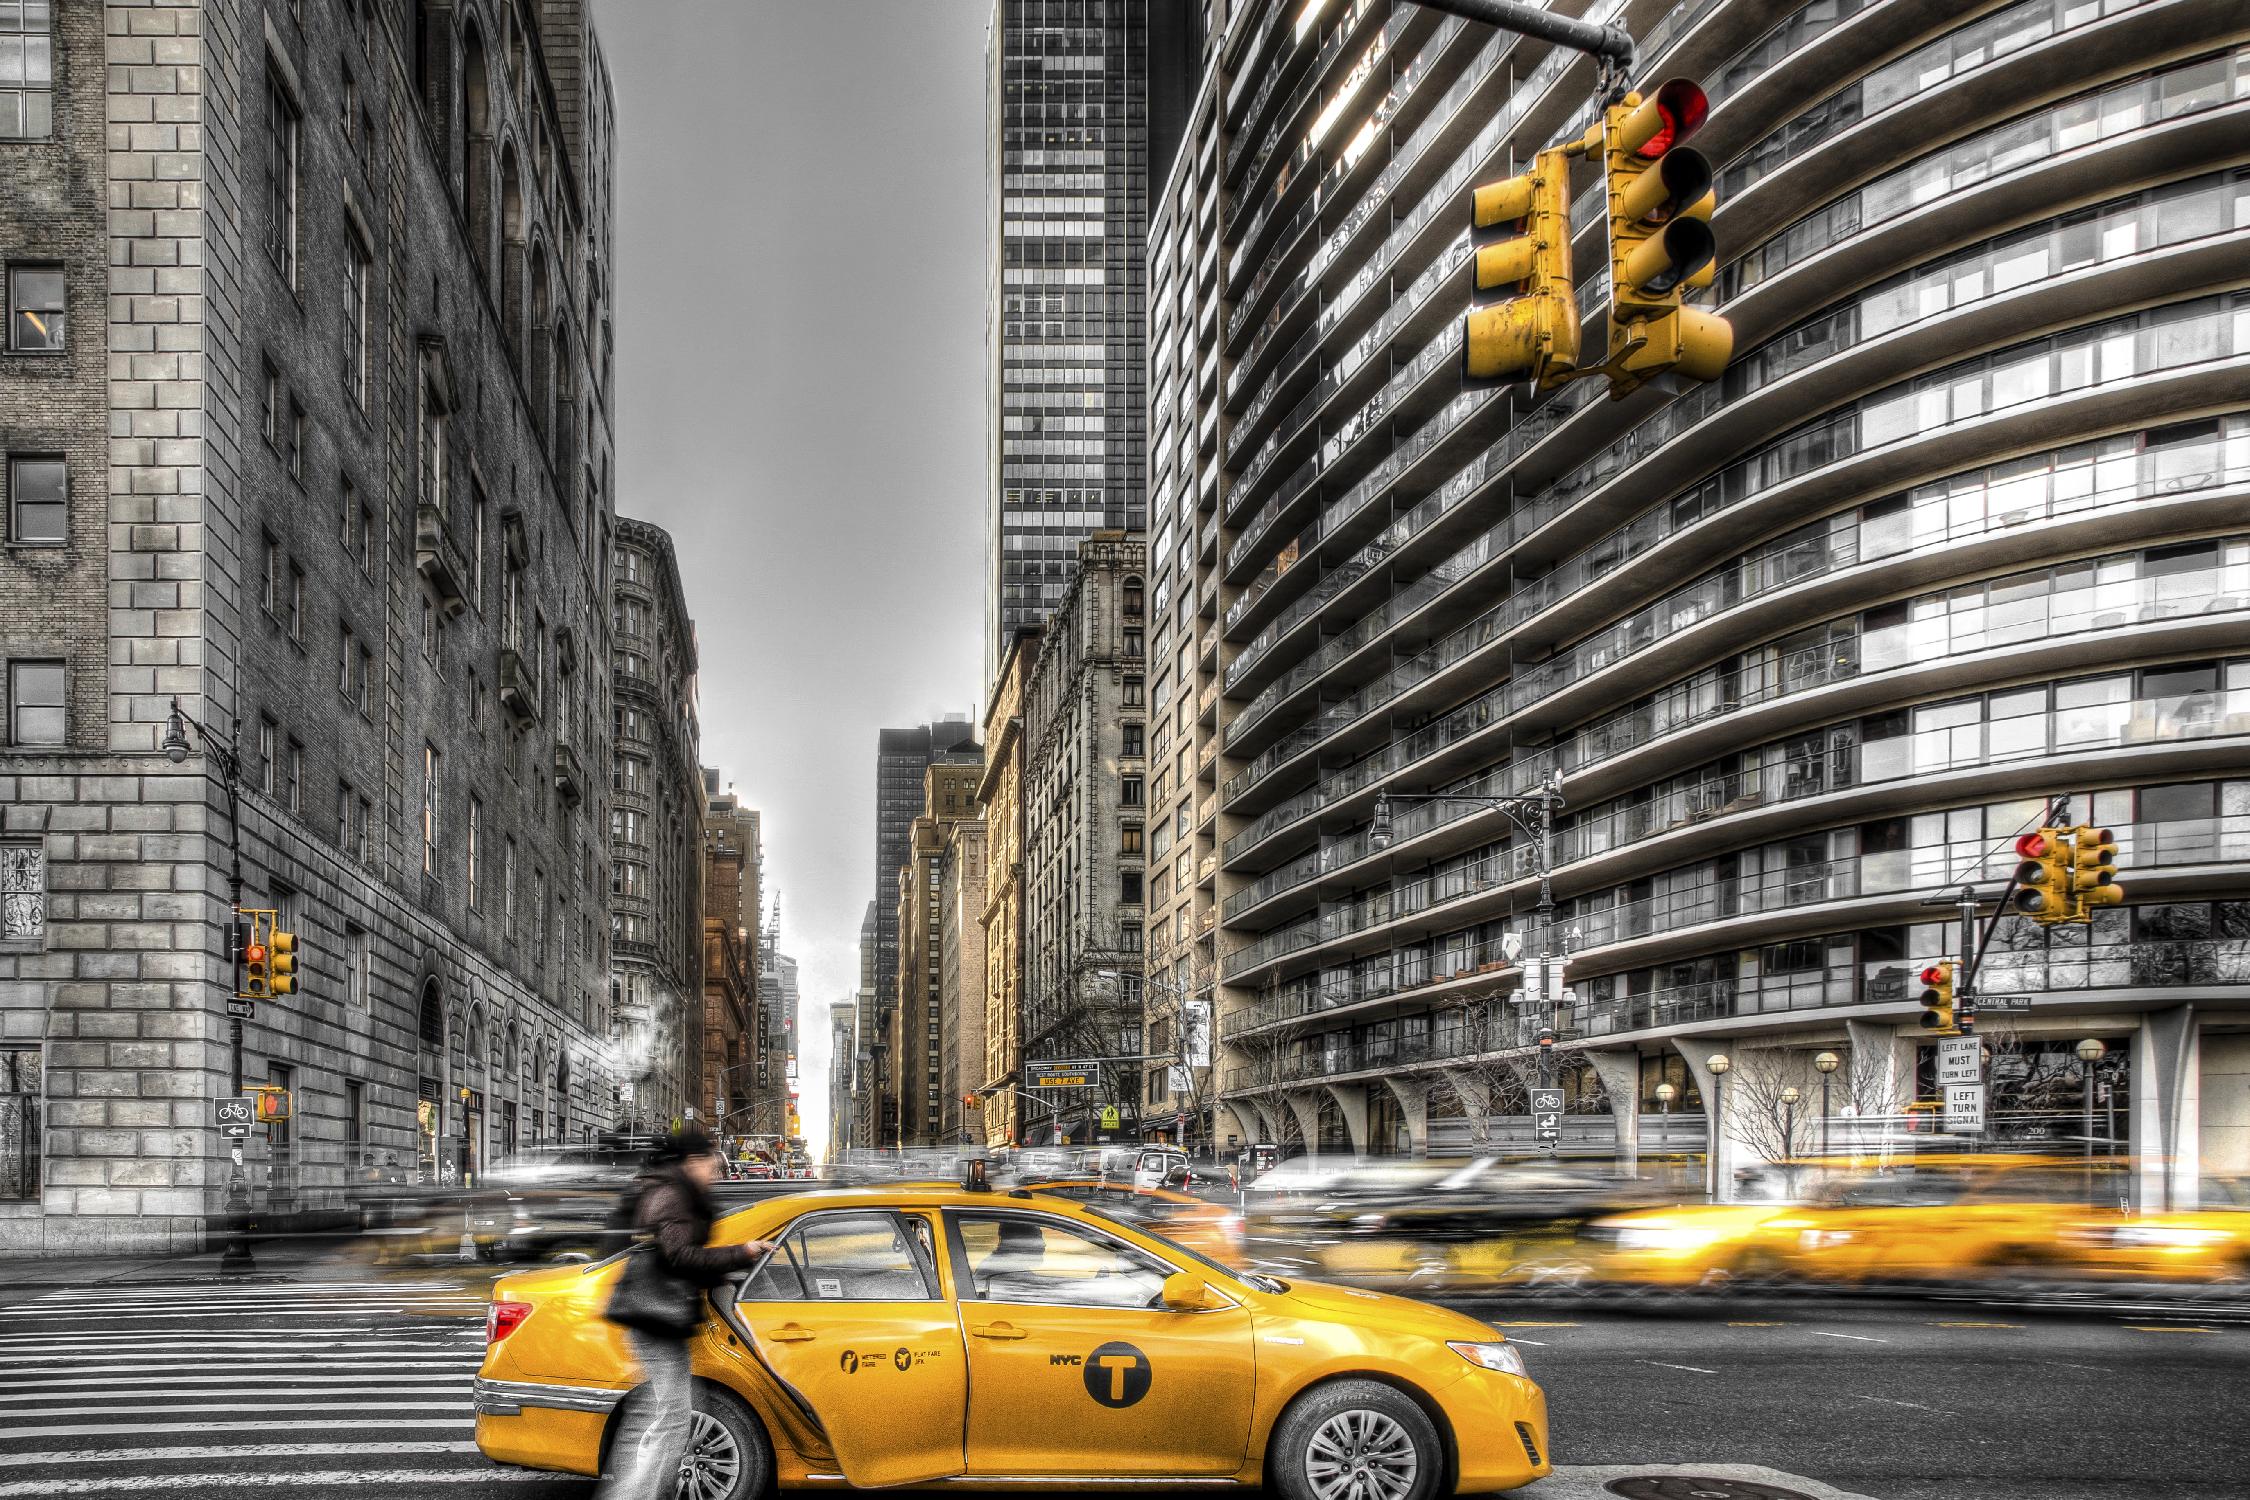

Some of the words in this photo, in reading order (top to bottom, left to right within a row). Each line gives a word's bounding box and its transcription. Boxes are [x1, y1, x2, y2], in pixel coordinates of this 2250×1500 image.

[1977, 997, 2008, 1006] CENTRAL
[2010, 998, 2029, 1006] PARK
[1941, 1043, 1957, 1052] LEFT
[1960, 1042, 1977, 1051] LANE
[1948, 1056, 1970, 1065] MUST
[1953, 1091, 1975, 1101] LEFT
[1952, 1104, 1976, 1112] TURN
[1947, 1115, 1981, 1125] SIGNAL
[2027, 1127, 2045, 1135] 200
[1049, 1354, 1082, 1366] NYC
[1099, 1355, 1137, 1400] T
